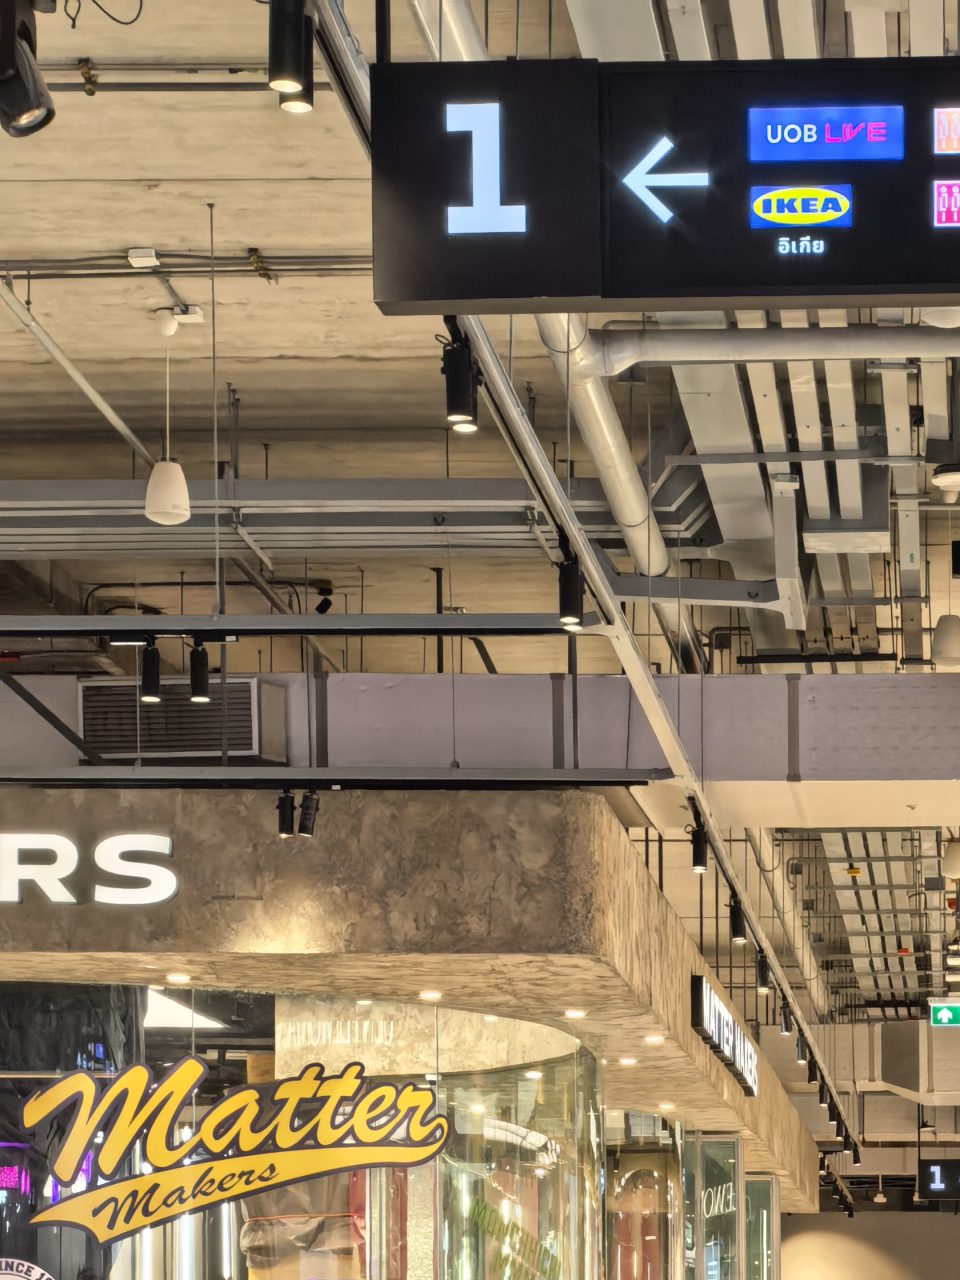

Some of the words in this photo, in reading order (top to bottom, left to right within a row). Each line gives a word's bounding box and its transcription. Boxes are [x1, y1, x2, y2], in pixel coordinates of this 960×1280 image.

[766, 124, 818, 144] UOB
[824, 121, 887, 143] LIVE
[446, 103, 527, 234] 1
[761, 197, 843, 214] IKEA
[778, 235, 825, 254] อิเกีย
[0, 833, 179, 905] RS
[22, 1057, 448, 1187] Matter
[92, 1162, 279, 1230] Makers
[930, 1166, 945, 1189] 1
